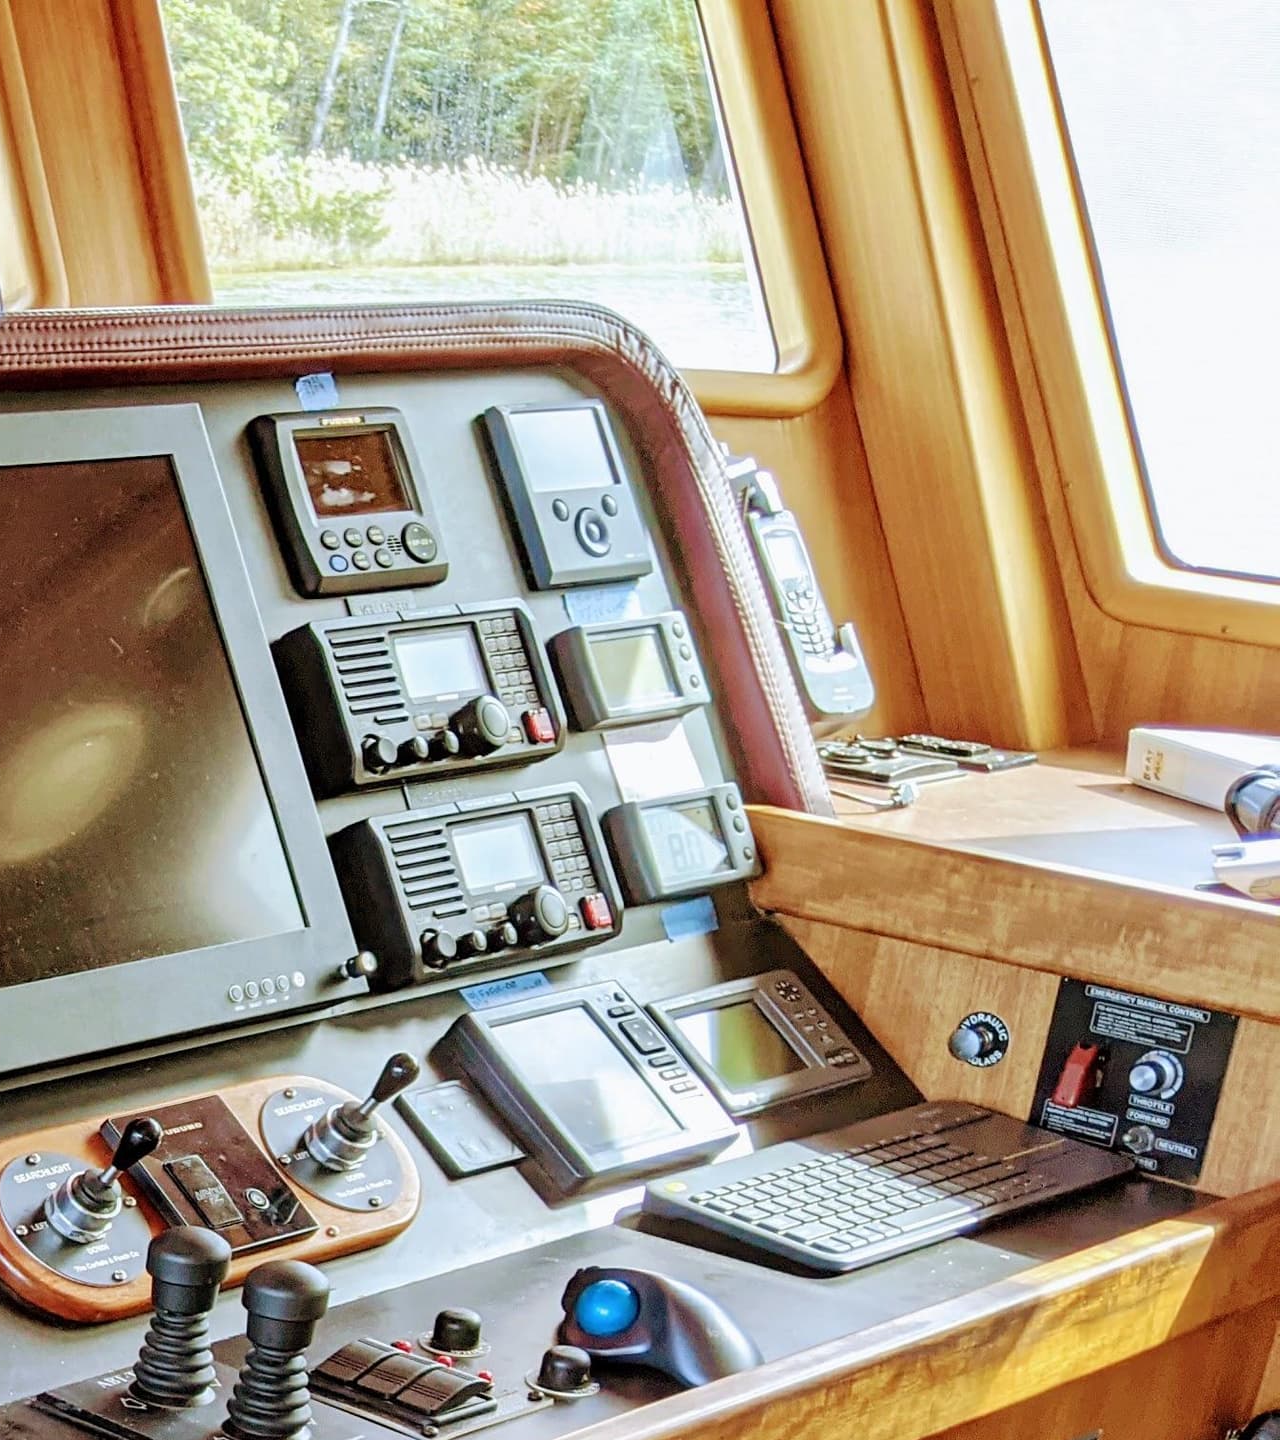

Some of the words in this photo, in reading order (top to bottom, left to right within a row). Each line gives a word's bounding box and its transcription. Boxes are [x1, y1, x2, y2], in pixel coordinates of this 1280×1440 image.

[1090, 987, 1135, 1004] EMERGENCY
[1137, 998, 1167, 1013] MANUAL
[1168, 1004, 1205, 1021] CONTROL
[961, 1012, 1008, 1041] YDRAULIC
[1133, 1098, 1170, 1112] THROTTLE
[163, 1122, 203, 1136] URUNO
[1158, 1140, 1192, 1155] NEUTRAL
[13, 1163, 72, 1183] SEARCHLIGHT
[30, 1221, 49, 1232] LEFT
